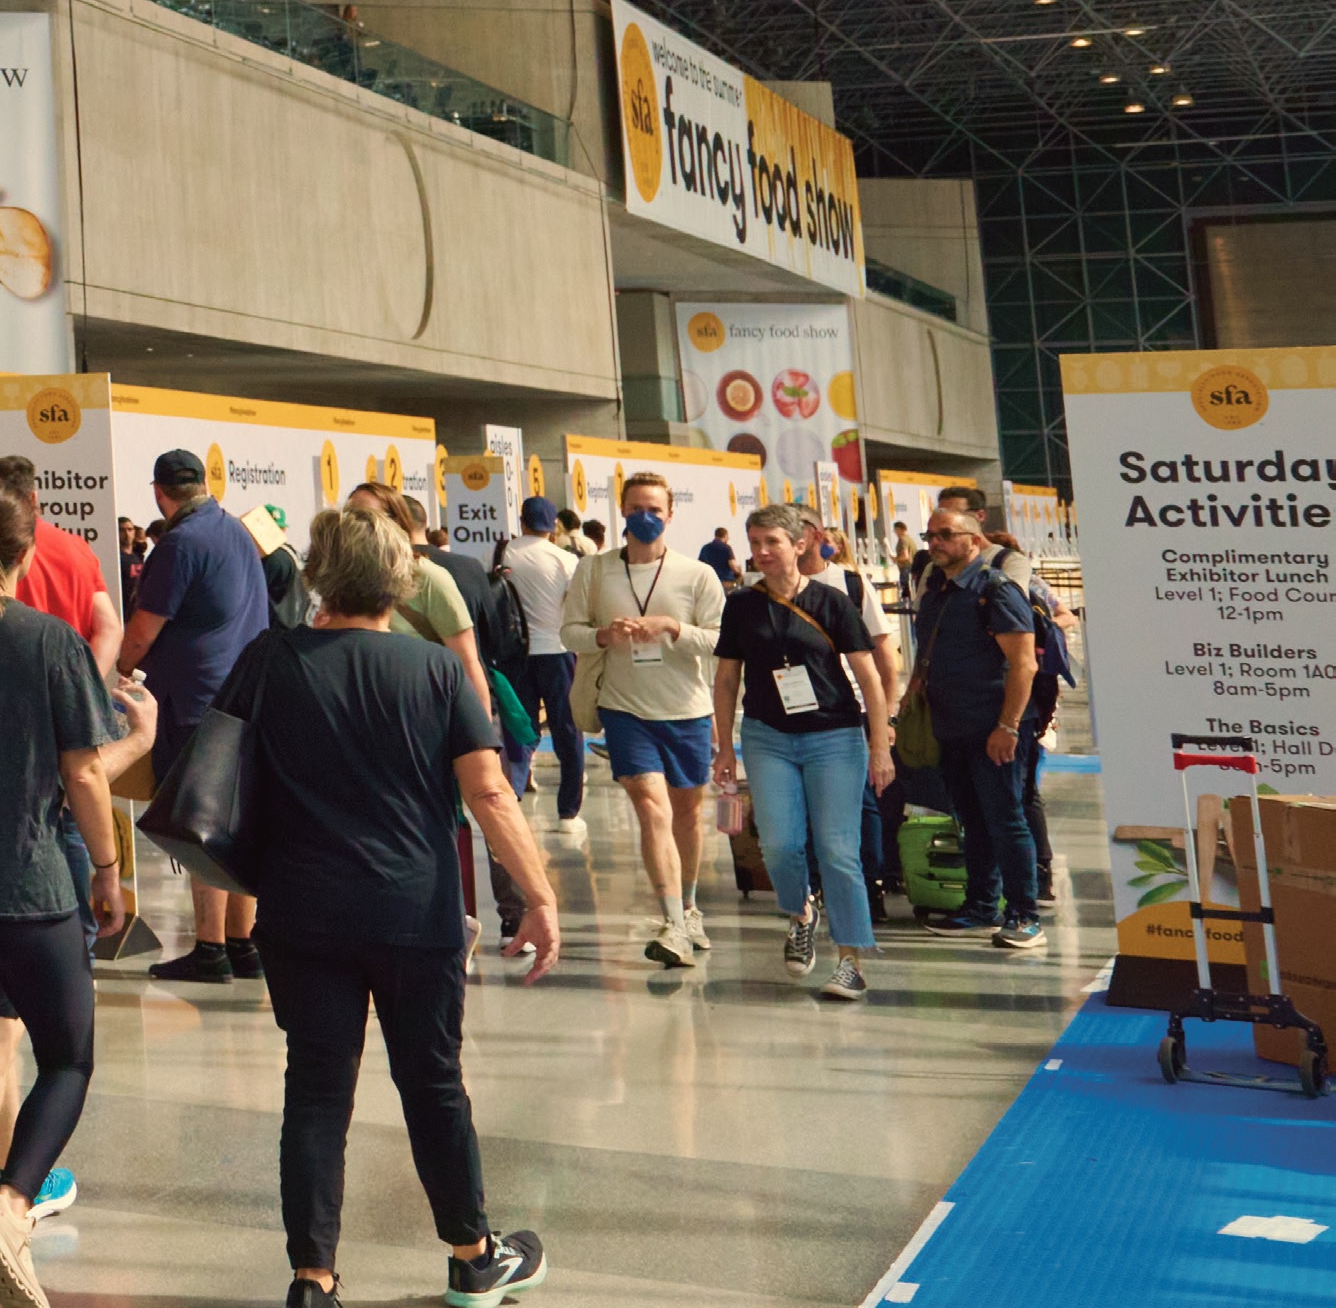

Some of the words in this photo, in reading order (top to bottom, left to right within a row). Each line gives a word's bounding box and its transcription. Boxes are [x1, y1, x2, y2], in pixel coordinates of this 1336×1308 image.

[651, 36, 689, 80] welcome
[689, 55, 699, 86] to
[699, 60, 712, 93] the
[631, 78, 654, 137] sfa
[663, 75, 746, 244] fancy
[747, 119, 803, 239] food
[804, 157, 855, 261] show
[697, 323, 717, 338] sfa
[729, 323, 765, 341] fancy
[769, 324, 800, 338] food
[803, 326, 839, 338] show
[1209, 384, 1253, 406] sfa
[39, 403, 69, 423] sfa
[228, 459, 286, 490] Registration
[327, 453, 333, 490] 1
[389, 457, 398, 490] 2
[40, 501, 94, 521] roup
[458, 503, 497, 521] Exit
[1161, 549, 1329, 568] Complimentary
[1166, 568, 1259, 582] Exhibitor
[1266, 569, 1329, 583] Lunch
[1155, 586, 1203, 600] Level
[1209, 587, 1223, 601] 1;
[1229, 587, 1279, 601] Food
[1217, 605, 1283, 624] 12-1pm
[1193, 643, 1224, 657] Biz
[1229, 643, 1317, 659] Builders
[1165, 660, 1213, 676] Level
[1219, 663, 1233, 678] 1;
[1240, 662, 1296, 678] Room
[1214, 680, 1310, 701] 8am-5pm
[1205, 718, 1243, 733] The
[1249, 719, 1320, 736] Basics
[1272, 739, 1312, 755] Hall
